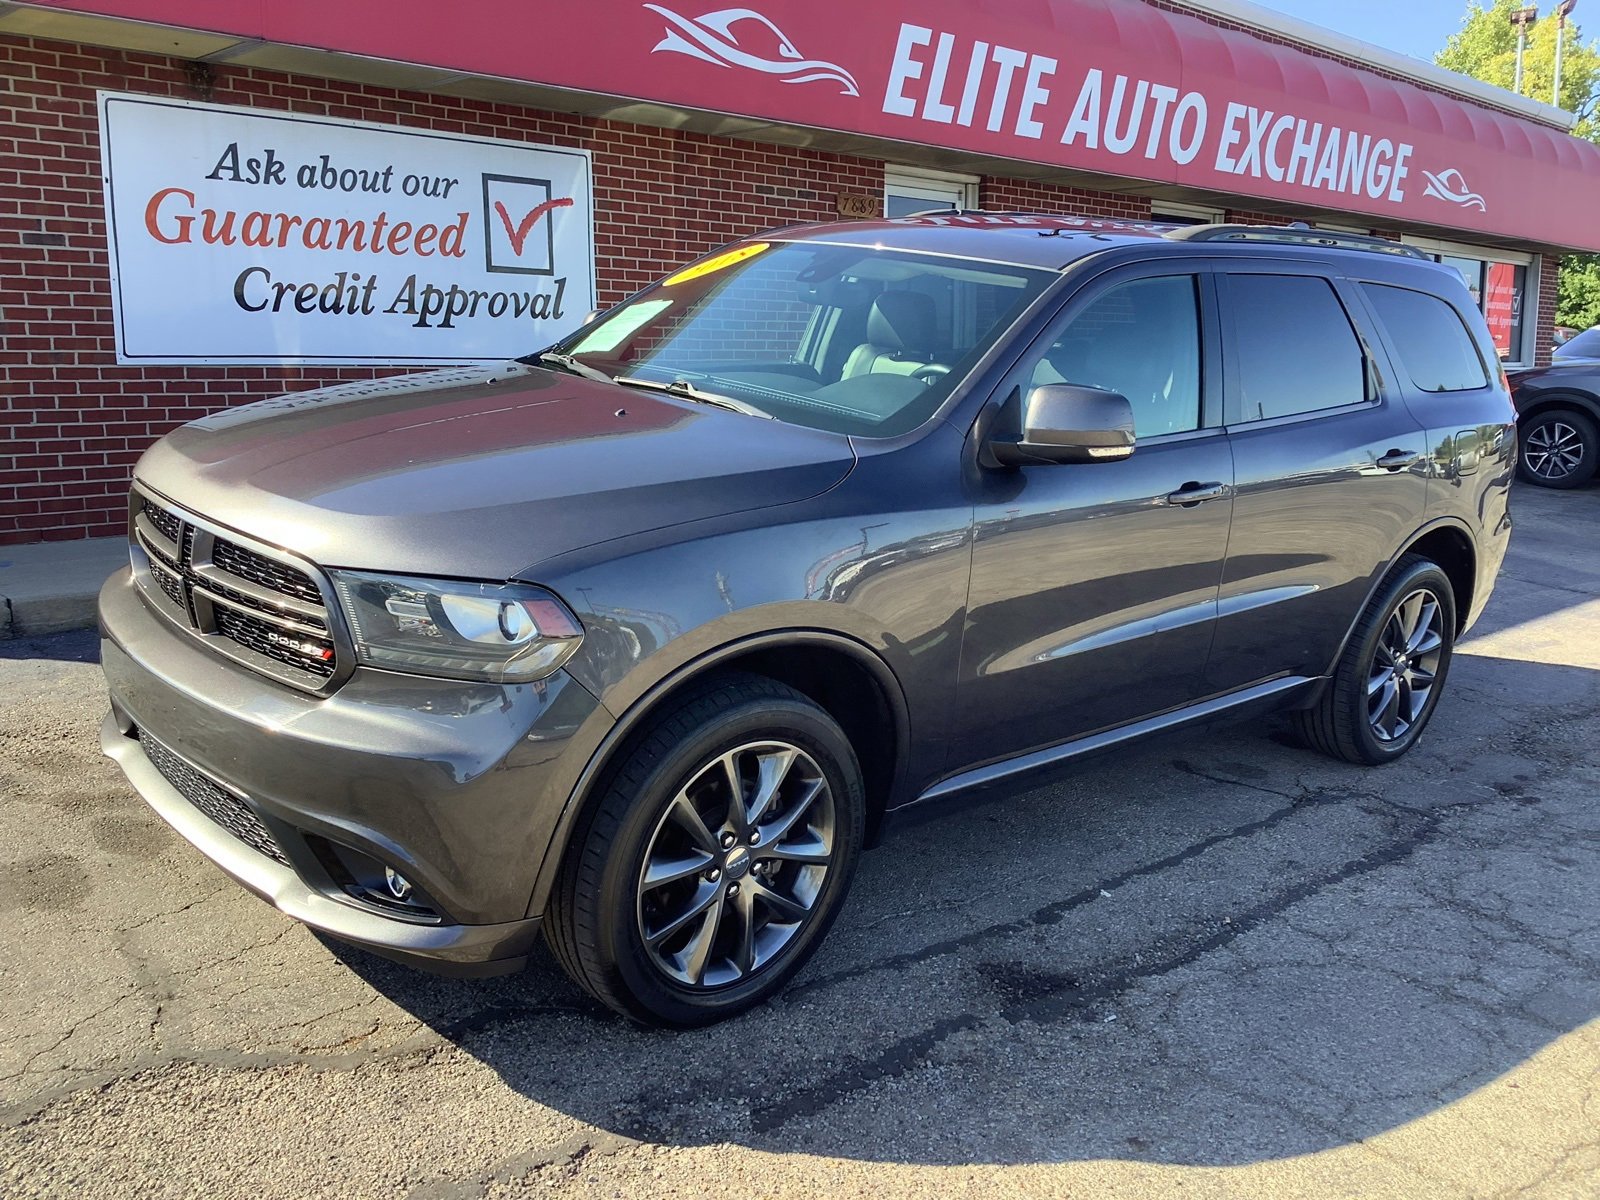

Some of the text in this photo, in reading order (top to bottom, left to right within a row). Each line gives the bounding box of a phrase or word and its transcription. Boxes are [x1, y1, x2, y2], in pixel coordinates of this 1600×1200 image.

[882, 22, 1414, 203] ELITE AUTO EXCHANGE
[204, 142, 459, 200] Ask about our
[144, 187, 470, 258] Guaranteed
[842, 196, 875, 215] 7889
[233, 266, 567, 329] Credit Approval
